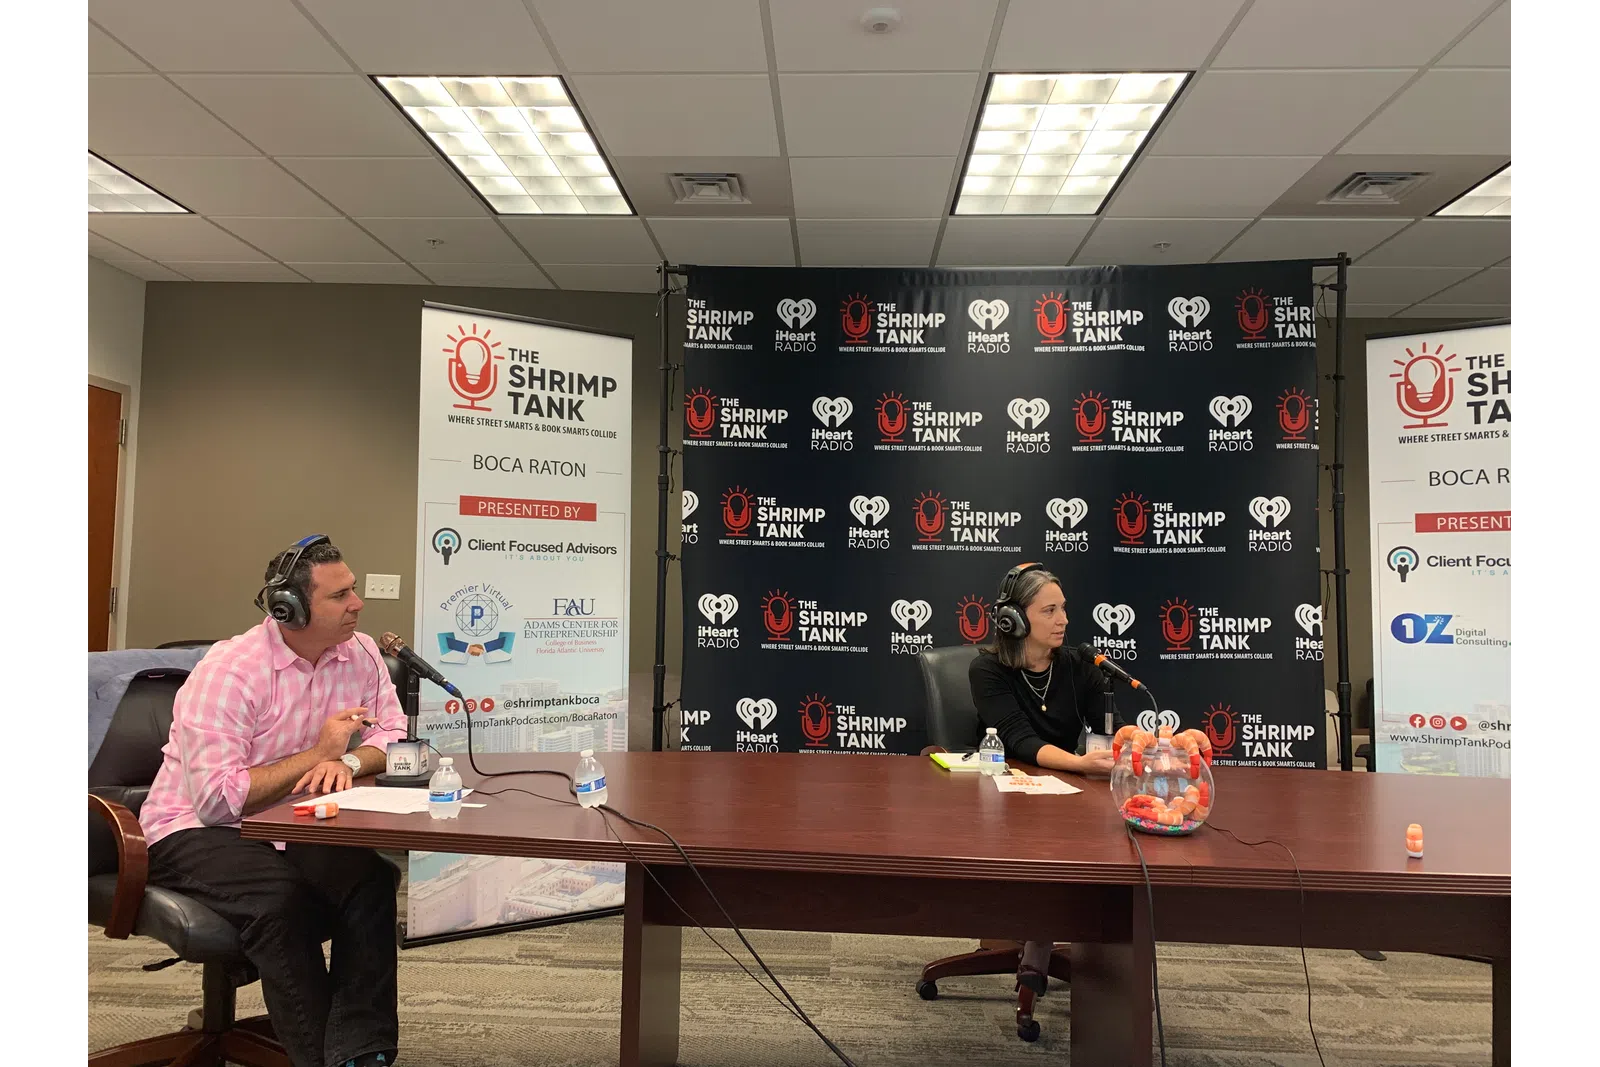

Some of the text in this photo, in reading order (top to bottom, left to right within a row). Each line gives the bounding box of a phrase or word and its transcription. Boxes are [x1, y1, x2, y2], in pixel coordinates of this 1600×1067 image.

[688, 299, 706, 308] THE
[877, 302, 896, 312] THE
[1072, 302, 1092, 311] THE
[1273, 297, 1293, 306] THE
[687, 309, 754, 325] SHRIMP
[876, 312, 946, 328] SHRIMP
[1072, 310, 1144, 327] SHRIMP
[687, 325, 732, 341] TANK
[775, 330, 816, 342] iHeart
[876, 329, 924, 344] TANK
[968, 332, 1009, 343] iHeart
[1072, 326, 1123, 343] TANK
[1169, 329, 1212, 341] iHeart
[775, 342, 816, 352] RADIO
[968, 343, 1010, 353] RADIO
[1169, 341, 1213, 352] RADIO
[508, 348, 539, 364] THE
[1465, 354, 1505, 370] THE
[508, 365, 617, 398] SHRIMP
[508, 391, 585, 422] TANK
[720, 398, 739, 407] THE
[913, 402, 932, 410] THE
[1112, 400, 1131, 410] THE
[720, 408, 788, 423] SHRIMP
[913, 411, 983, 426] SHRIMP
[1112, 410, 1184, 426] SHRIMP
[448, 415, 475, 425] WHERE
[477, 418, 503, 428] STREET
[504, 421, 533, 431] SMARTS
[542, 425, 561, 433] BOOK
[562, 427, 589, 436] SMARTS
[591, 430, 617, 439] COLLIDE
[720, 424, 767, 439] TANK
[812, 428, 853, 440] iHeart
[912, 428, 961, 443] TANK
[1007, 431, 1050, 442] iHeart
[1112, 427, 1162, 443] TANK
[1209, 429, 1252, 441] iHeart
[1398, 430, 1509, 444] WHERE STREET SMARTS &
[811, 440, 853, 451] RADIO
[1006, 443, 1050, 453] RADIO
[1209, 441, 1253, 451] RADIO
[473, 454, 586, 478] BOCA RATON
[1429, 469, 1490, 487] BOCA
[757, 497, 776, 506] THE
[951, 501, 970, 510] THE
[1153, 503, 1173, 511] THE
[478, 501, 580, 518] PRESENTED BY
[757, 507, 826, 522] SHRIMP
[951, 511, 1021, 527] SHRIMP
[1153, 512, 1225, 528] SHRIMP
[757, 523, 804, 538] TANK
[848, 526, 889, 539] iHeart
[950, 528, 999, 543] TANK
[1046, 530, 1088, 542] iHeart
[1153, 529, 1204, 545] TANK
[1249, 529, 1291, 540] iHeart
[468, 539, 617, 555] Client Focused Advisors
[848, 539, 890, 550] RADIO
[1045, 542, 1088, 552] RADIO
[1249, 541, 1292, 552] RADIO
[1427, 555, 1472, 568] Client
[440, 583, 513, 611] Premier Virtual
[553, 598, 595, 616] FAU
[799, 600, 817, 609] THE
[1198, 607, 1219, 616] THE
[524, 621, 560, 629] ADAMS
[562, 620, 599, 628] CENTER
[799, 610, 867, 626] SHRIMP
[1199, 617, 1272, 633] SHRIMP
[524, 630, 618, 638] ENTREPRENEURSHIP
[698, 626, 739, 638] iHeart
[799, 627, 847, 642] TANK
[891, 632, 932, 644] iHeart
[1456, 628, 1486, 638] Digital
[698, 638, 739, 648] RADIO
[1093, 636, 1136, 649] iHeart
[1199, 635, 1250, 650] TANK
[503, 695, 599, 710] @shrimptankboca
[836, 705, 855, 714] THE
[426, 712, 618, 731] www.ShimpTankPodcast.com/BocaRaton
[837, 716, 907, 733] SHRIMP
[1242, 714, 1262, 723] THE
[737, 730, 778, 744] iHeart
[1242, 725, 1314, 740] SHRIMP
[837, 733, 886, 749] TANK
[1242, 742, 1293, 758] TANK
